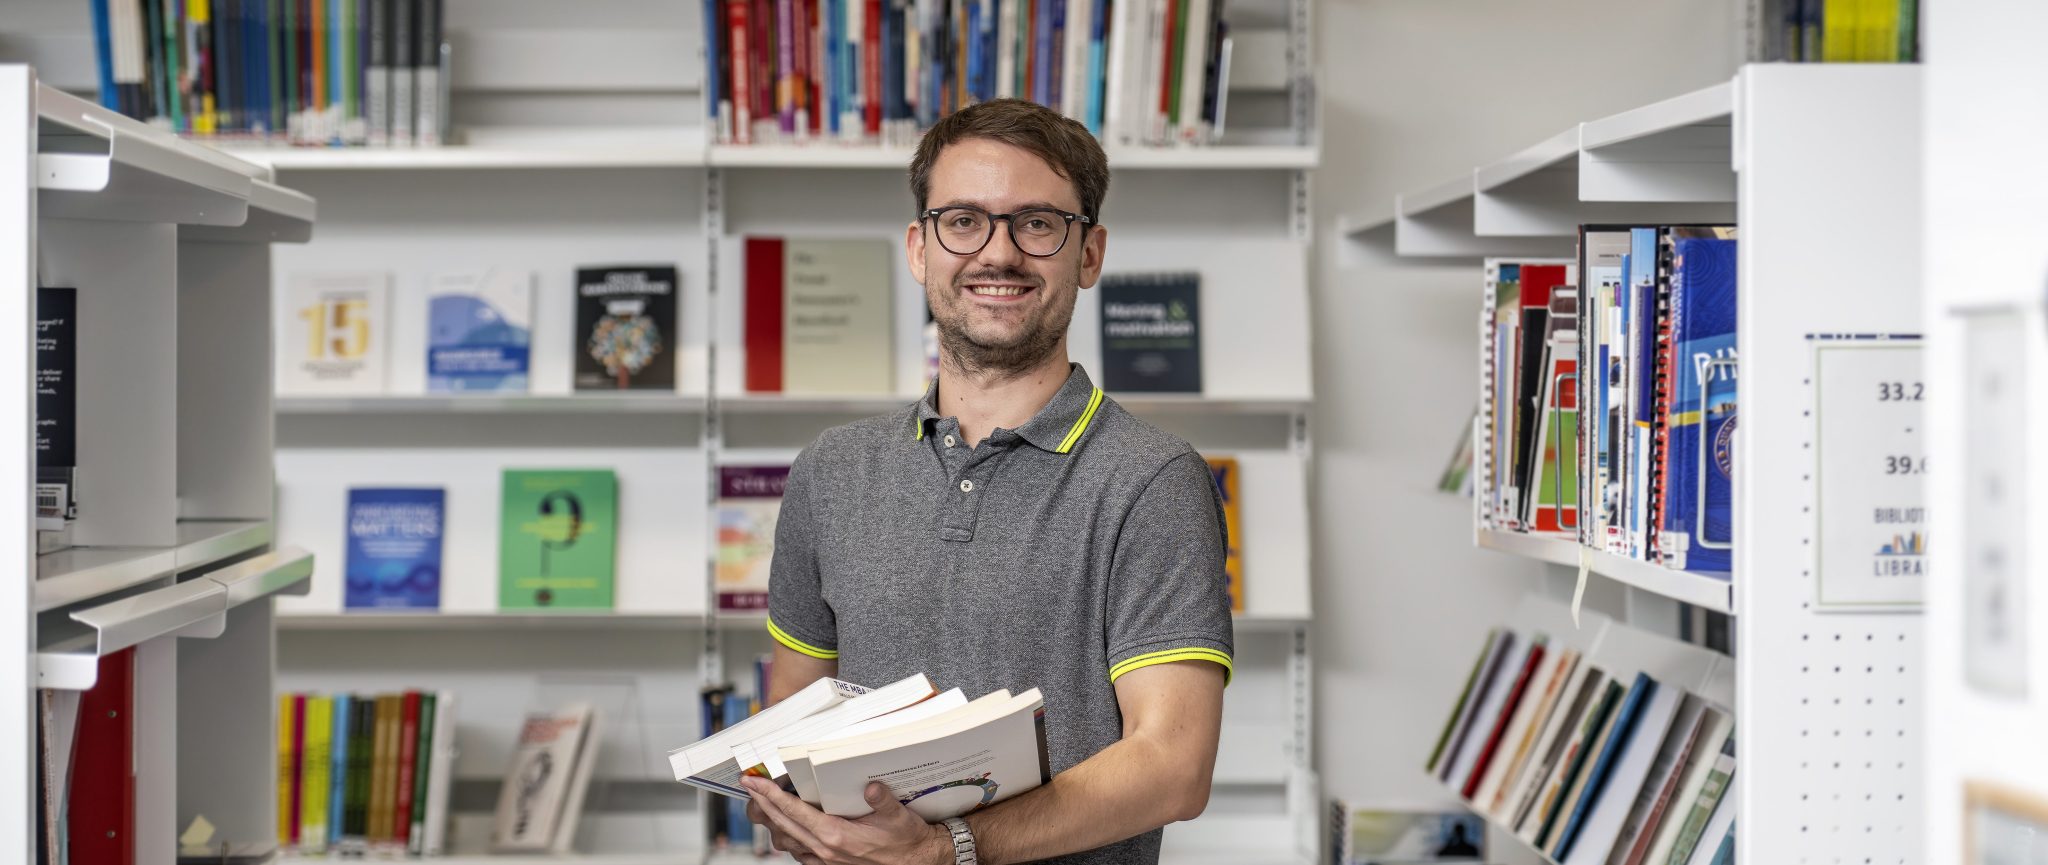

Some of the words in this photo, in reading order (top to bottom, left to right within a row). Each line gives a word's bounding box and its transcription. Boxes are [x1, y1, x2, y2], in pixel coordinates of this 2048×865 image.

[298, 302, 369, 360] 15
[1879, 382, 1925, 401] 33.2
[1874, 507, 1931, 524] BIBLIOT
[1874, 560, 1929, 577] LIBRA
[834, 680, 850, 692] THE
[850, 684, 867, 695] MBA
